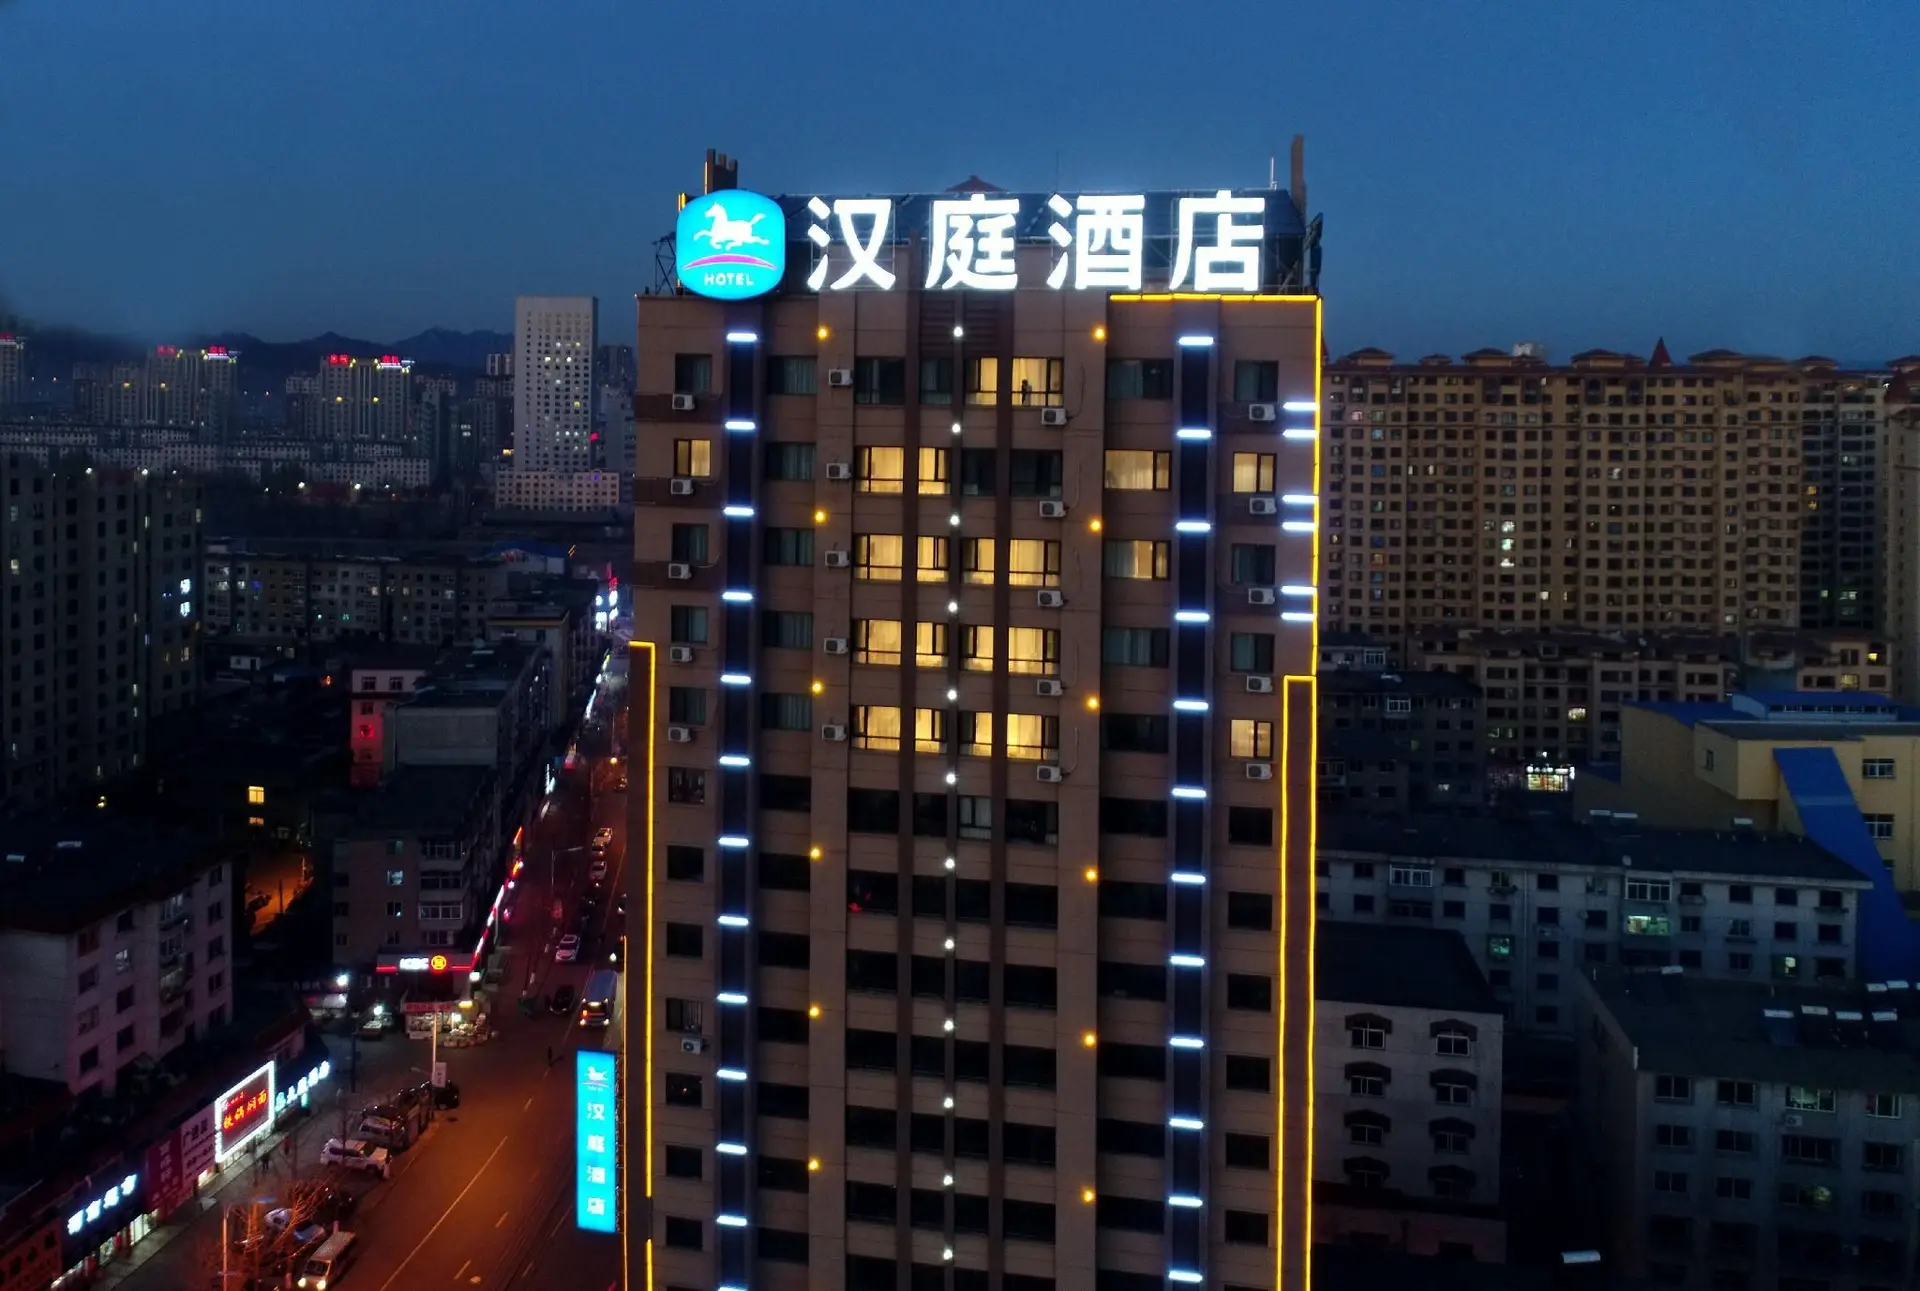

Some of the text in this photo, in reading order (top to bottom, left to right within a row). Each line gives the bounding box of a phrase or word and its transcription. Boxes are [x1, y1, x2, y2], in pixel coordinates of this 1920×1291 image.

[807, 190, 1265, 292] 汉庭酒店
[703, 272, 755, 287] HOTEL
